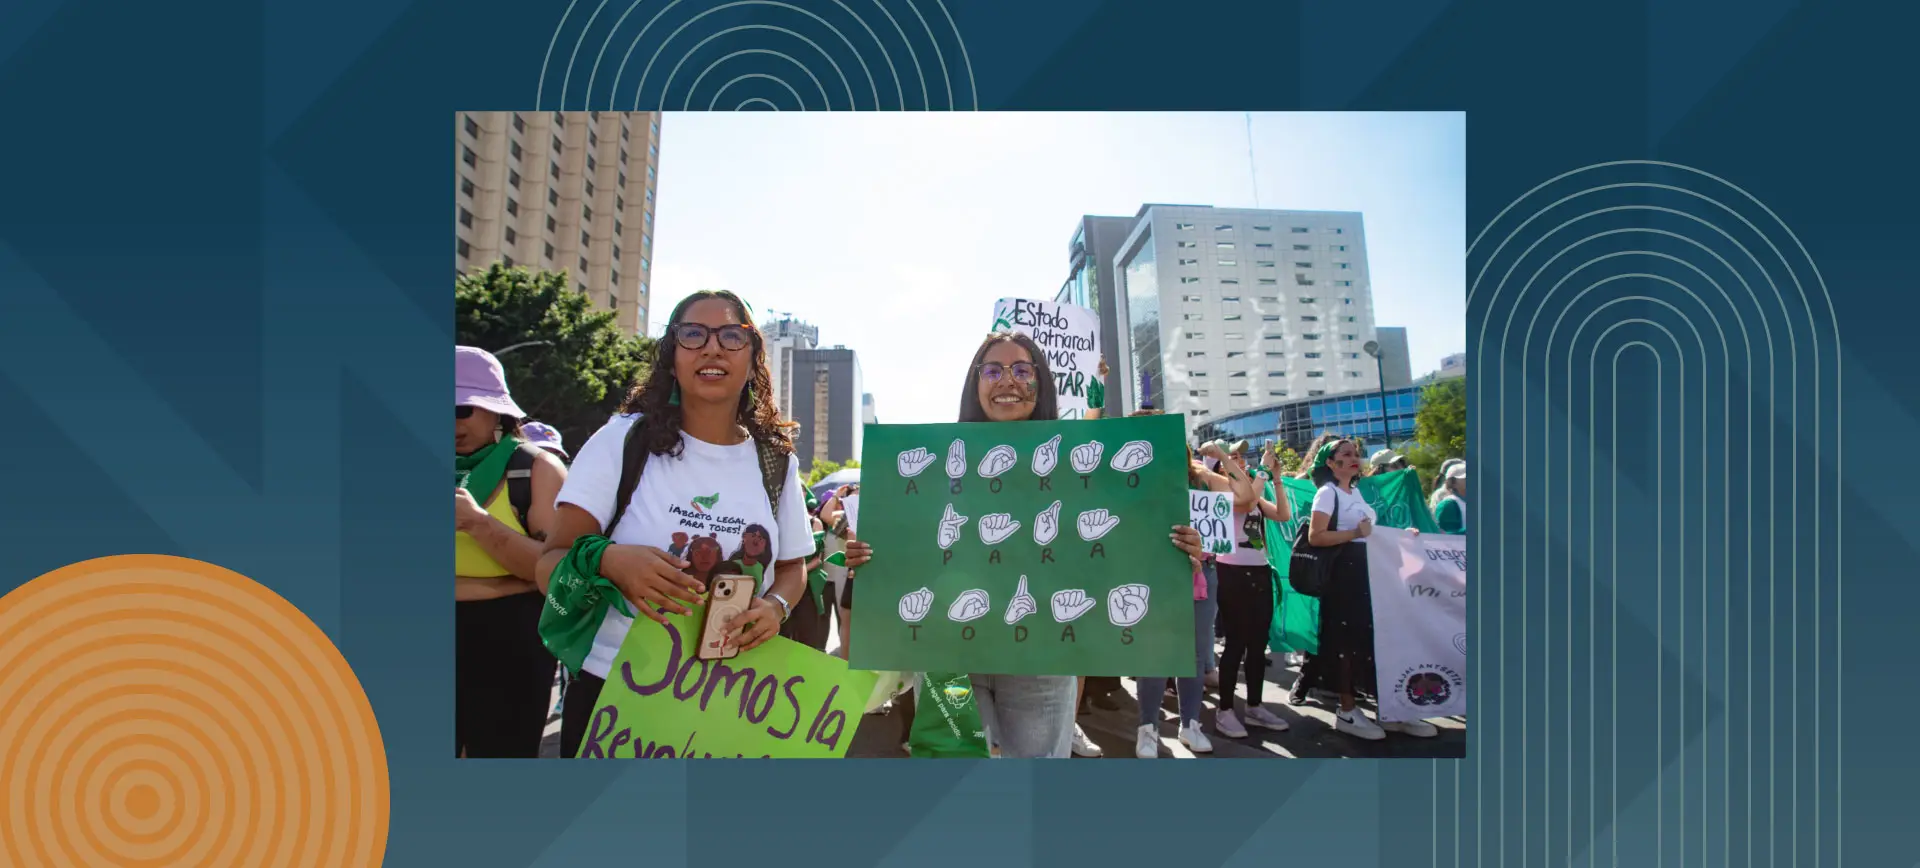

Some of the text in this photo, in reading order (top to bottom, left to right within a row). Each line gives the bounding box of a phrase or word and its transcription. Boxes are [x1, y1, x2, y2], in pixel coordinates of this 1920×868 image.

[1041, 348, 1077, 371] AMOS
[905, 473, 1140, 495] ABORTO
[679, 518, 742, 535] PARA TODES!
[716, 516, 746, 525] LEGAL
[943, 543, 1106, 565] PARA
[908, 624, 1135, 645] TODAS
